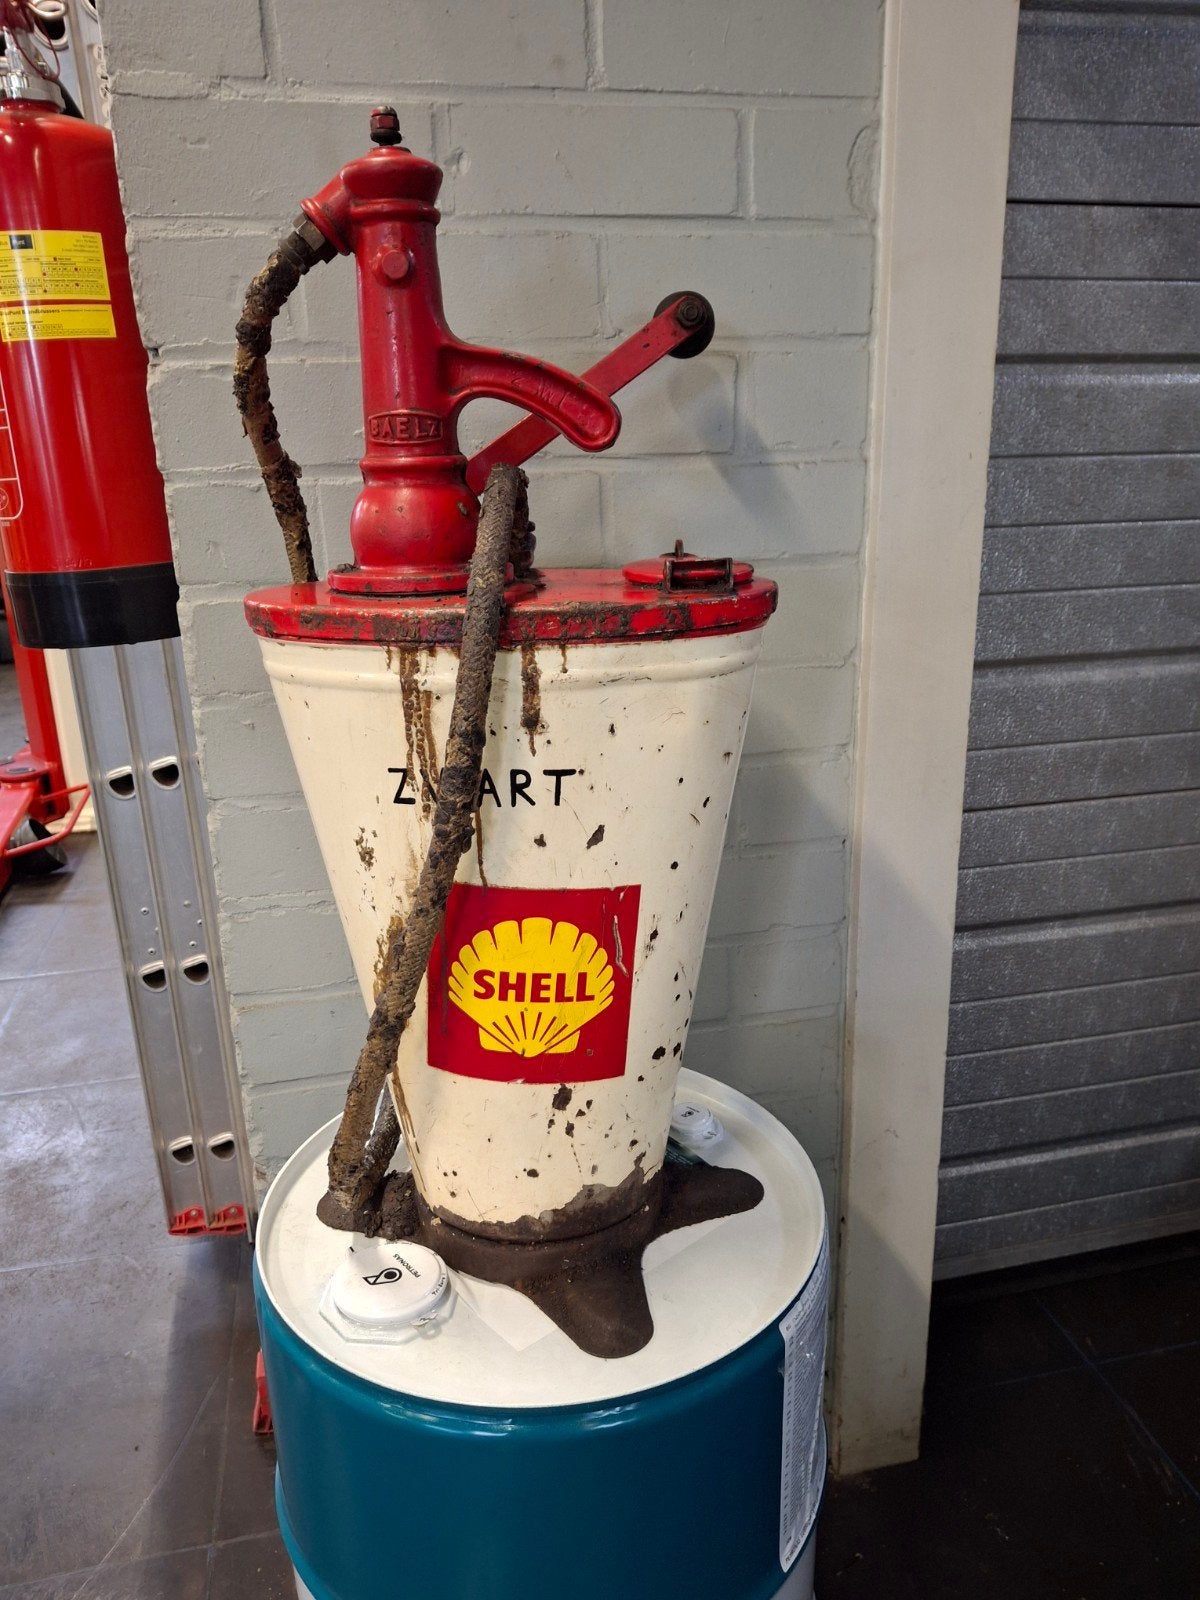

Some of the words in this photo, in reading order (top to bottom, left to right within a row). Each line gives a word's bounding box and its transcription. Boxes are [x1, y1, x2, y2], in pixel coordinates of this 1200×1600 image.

[370, 416, 437, 439] BAELZ
[472, 968, 595, 1003] SHELL
[393, 1253, 421, 1279] PETRONAS
